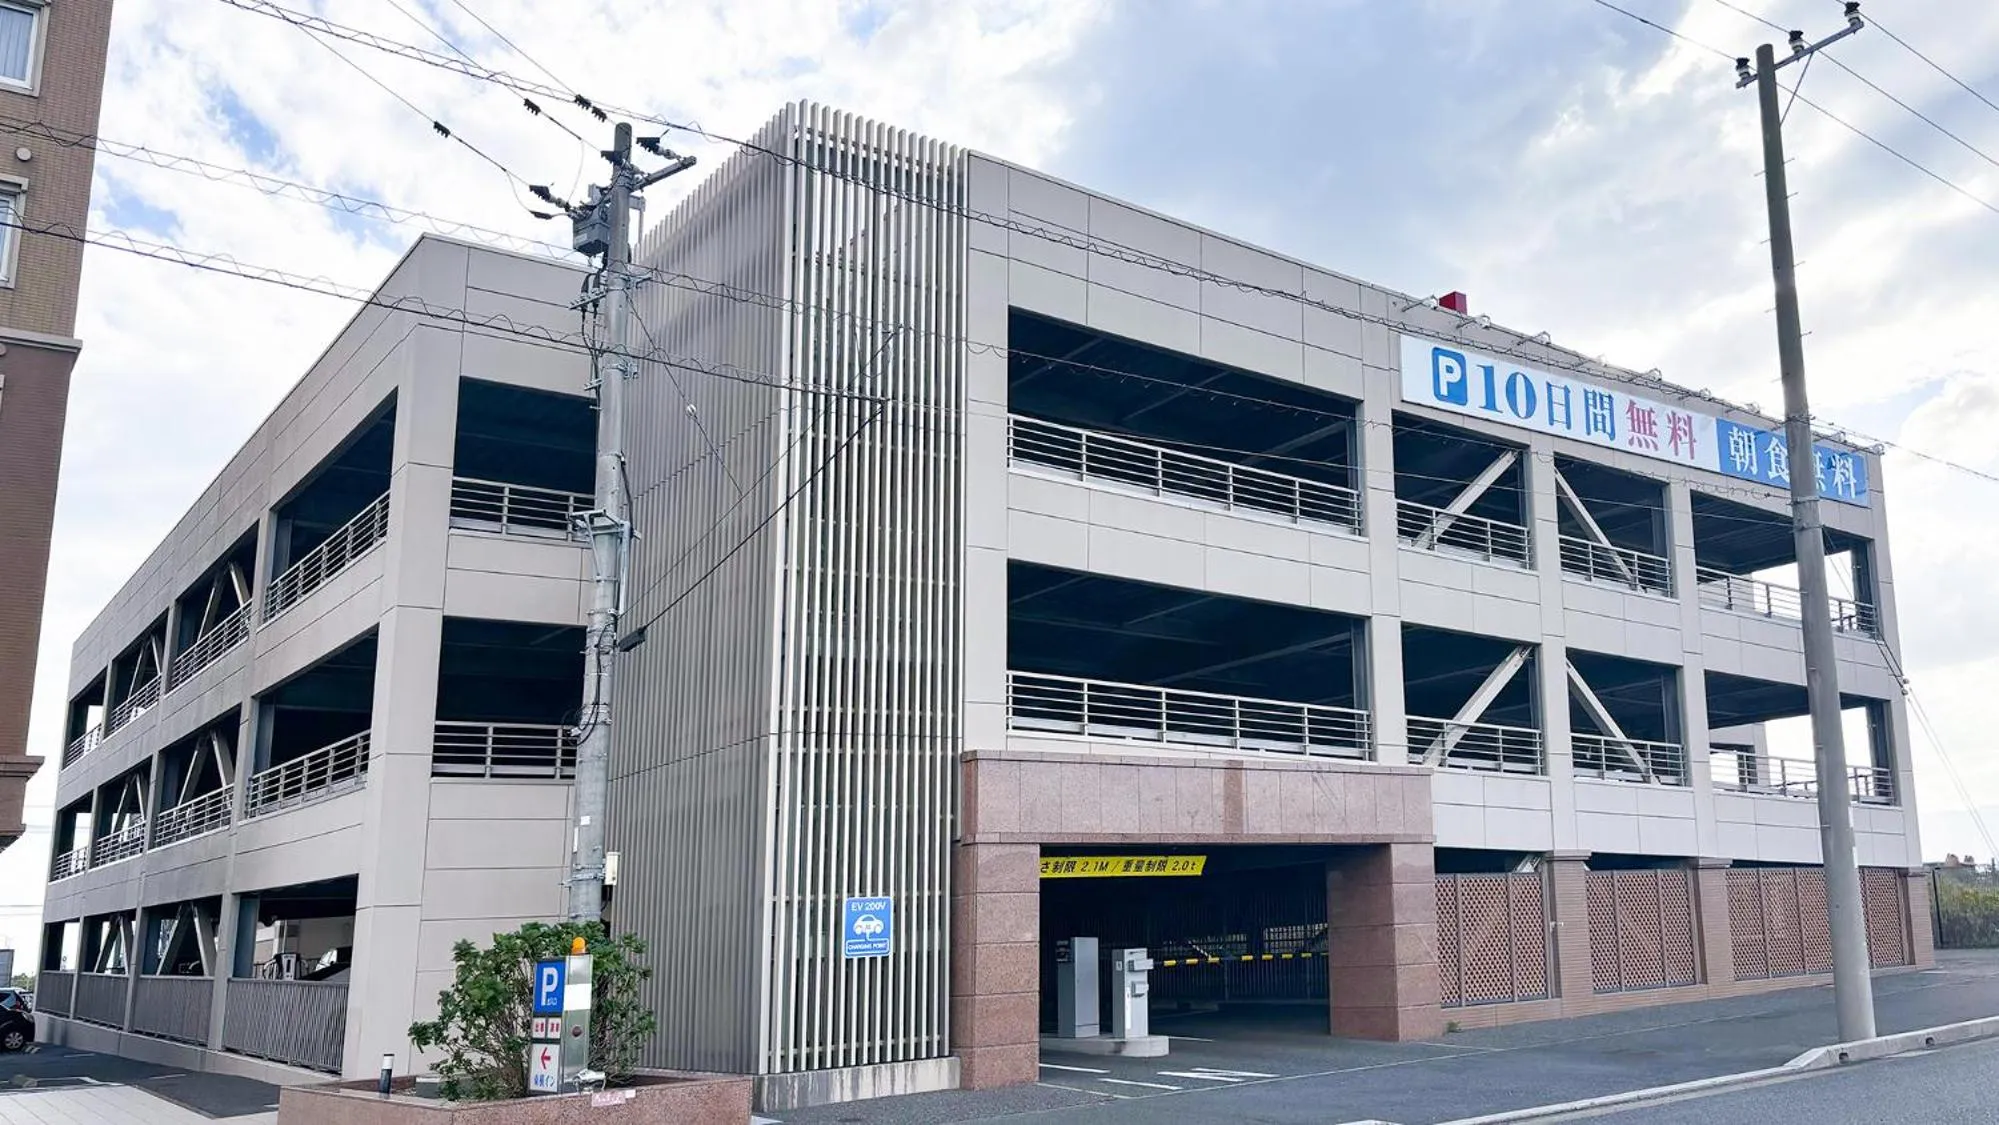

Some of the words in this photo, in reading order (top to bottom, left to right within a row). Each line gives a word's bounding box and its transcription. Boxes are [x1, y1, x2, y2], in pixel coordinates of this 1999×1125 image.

[851, 902, 864, 912] EV
[865, 901, 886, 911] 200V
[541, 967, 558, 1006] P
